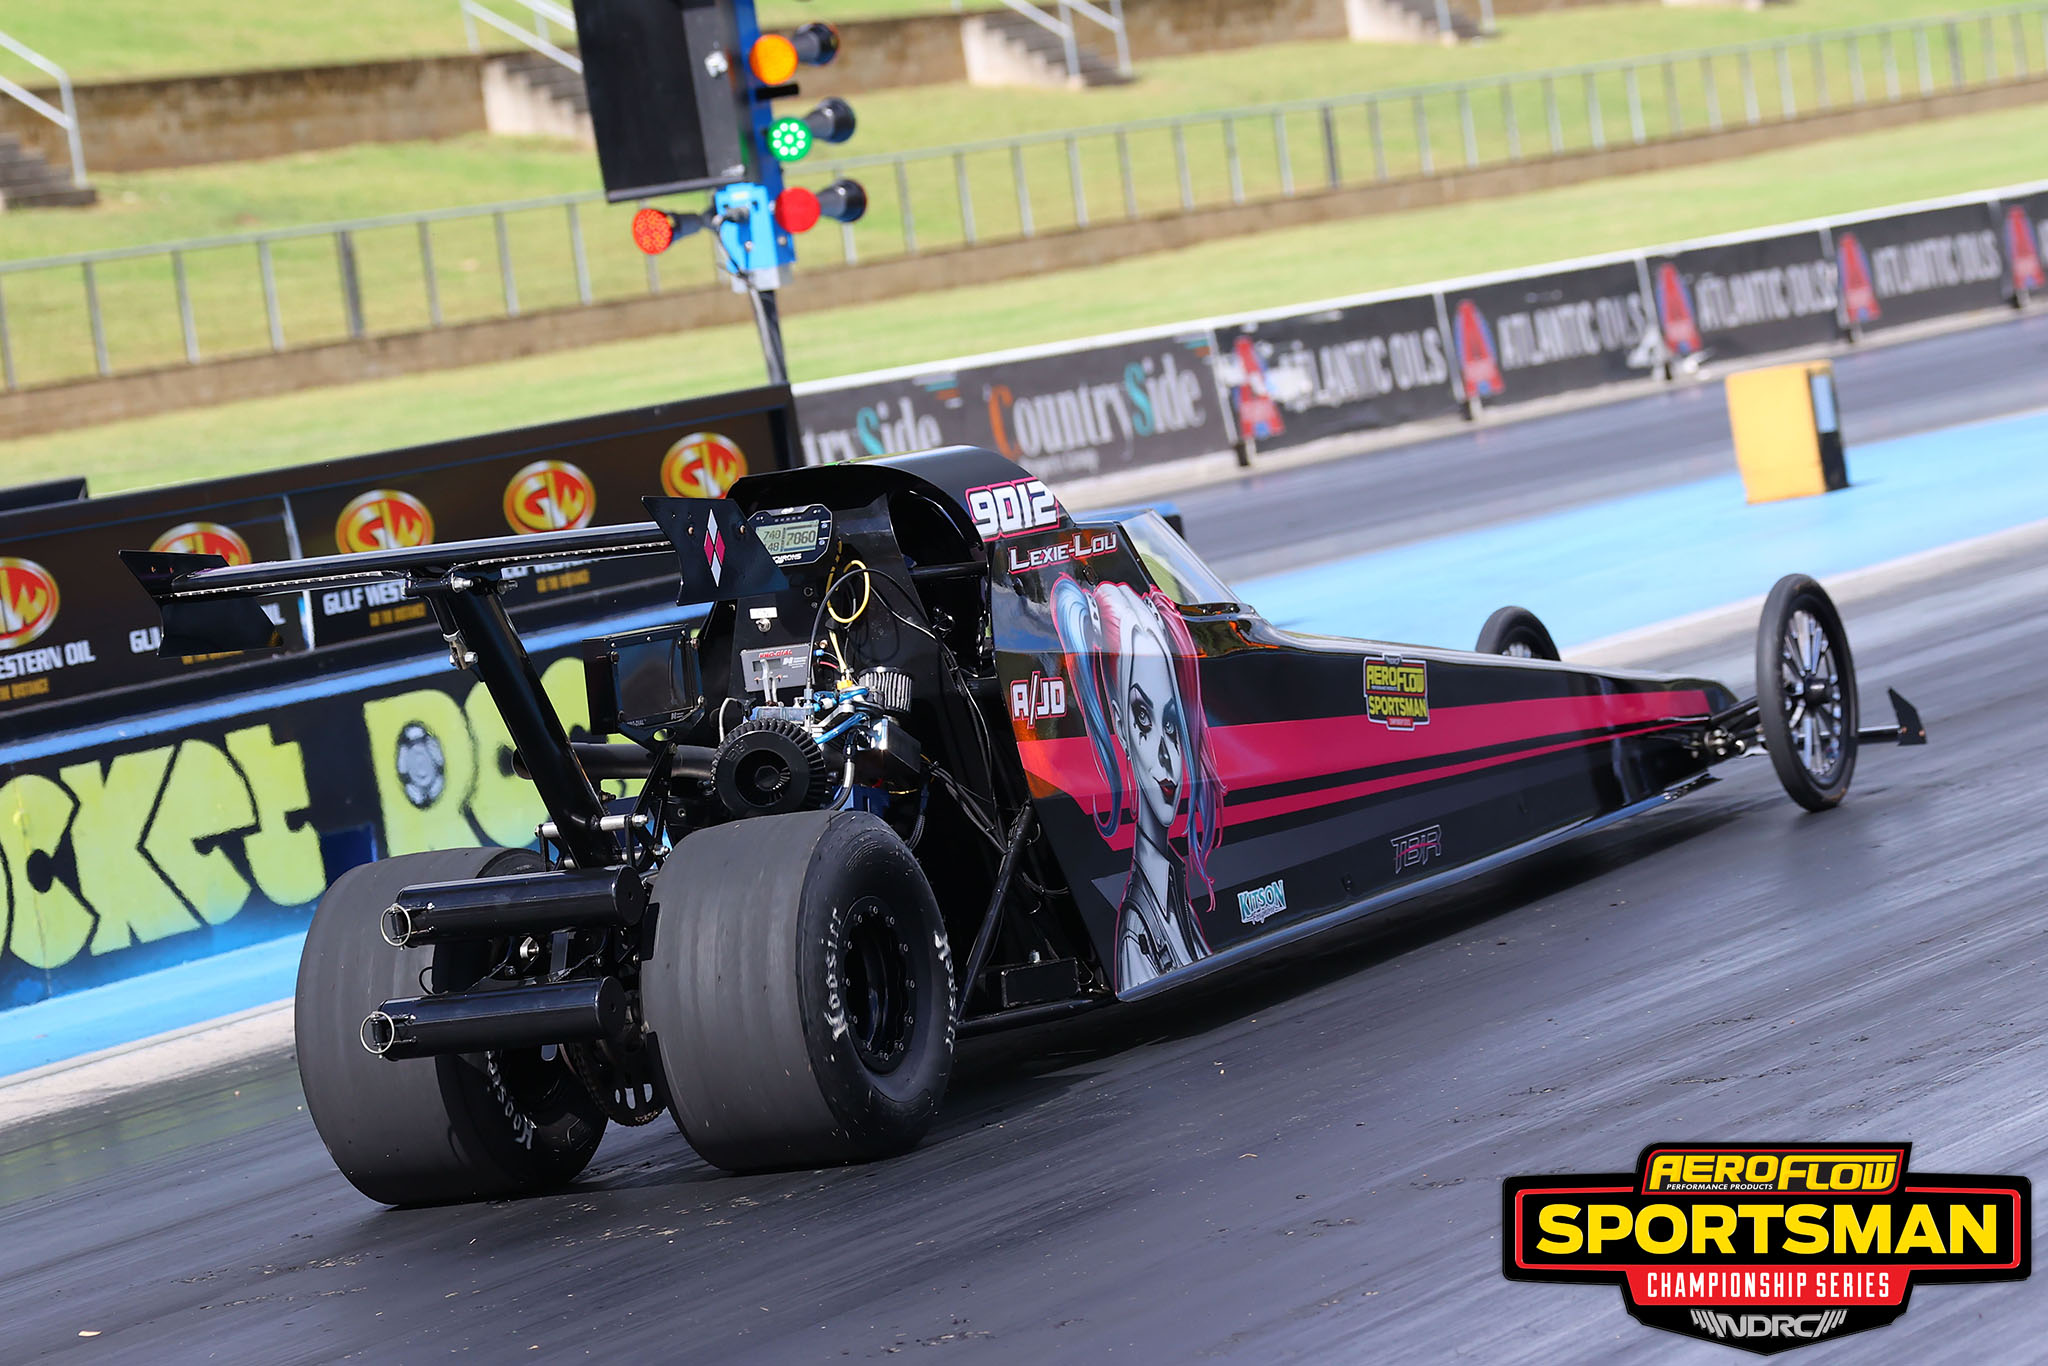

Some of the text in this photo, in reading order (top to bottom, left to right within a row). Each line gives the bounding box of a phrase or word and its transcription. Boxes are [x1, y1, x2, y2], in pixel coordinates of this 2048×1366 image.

[967, 478, 1058, 537] 9012
[1368, 695, 1428, 718] SPORTSMAN
[1237, 879, 1287, 922] KITSON
